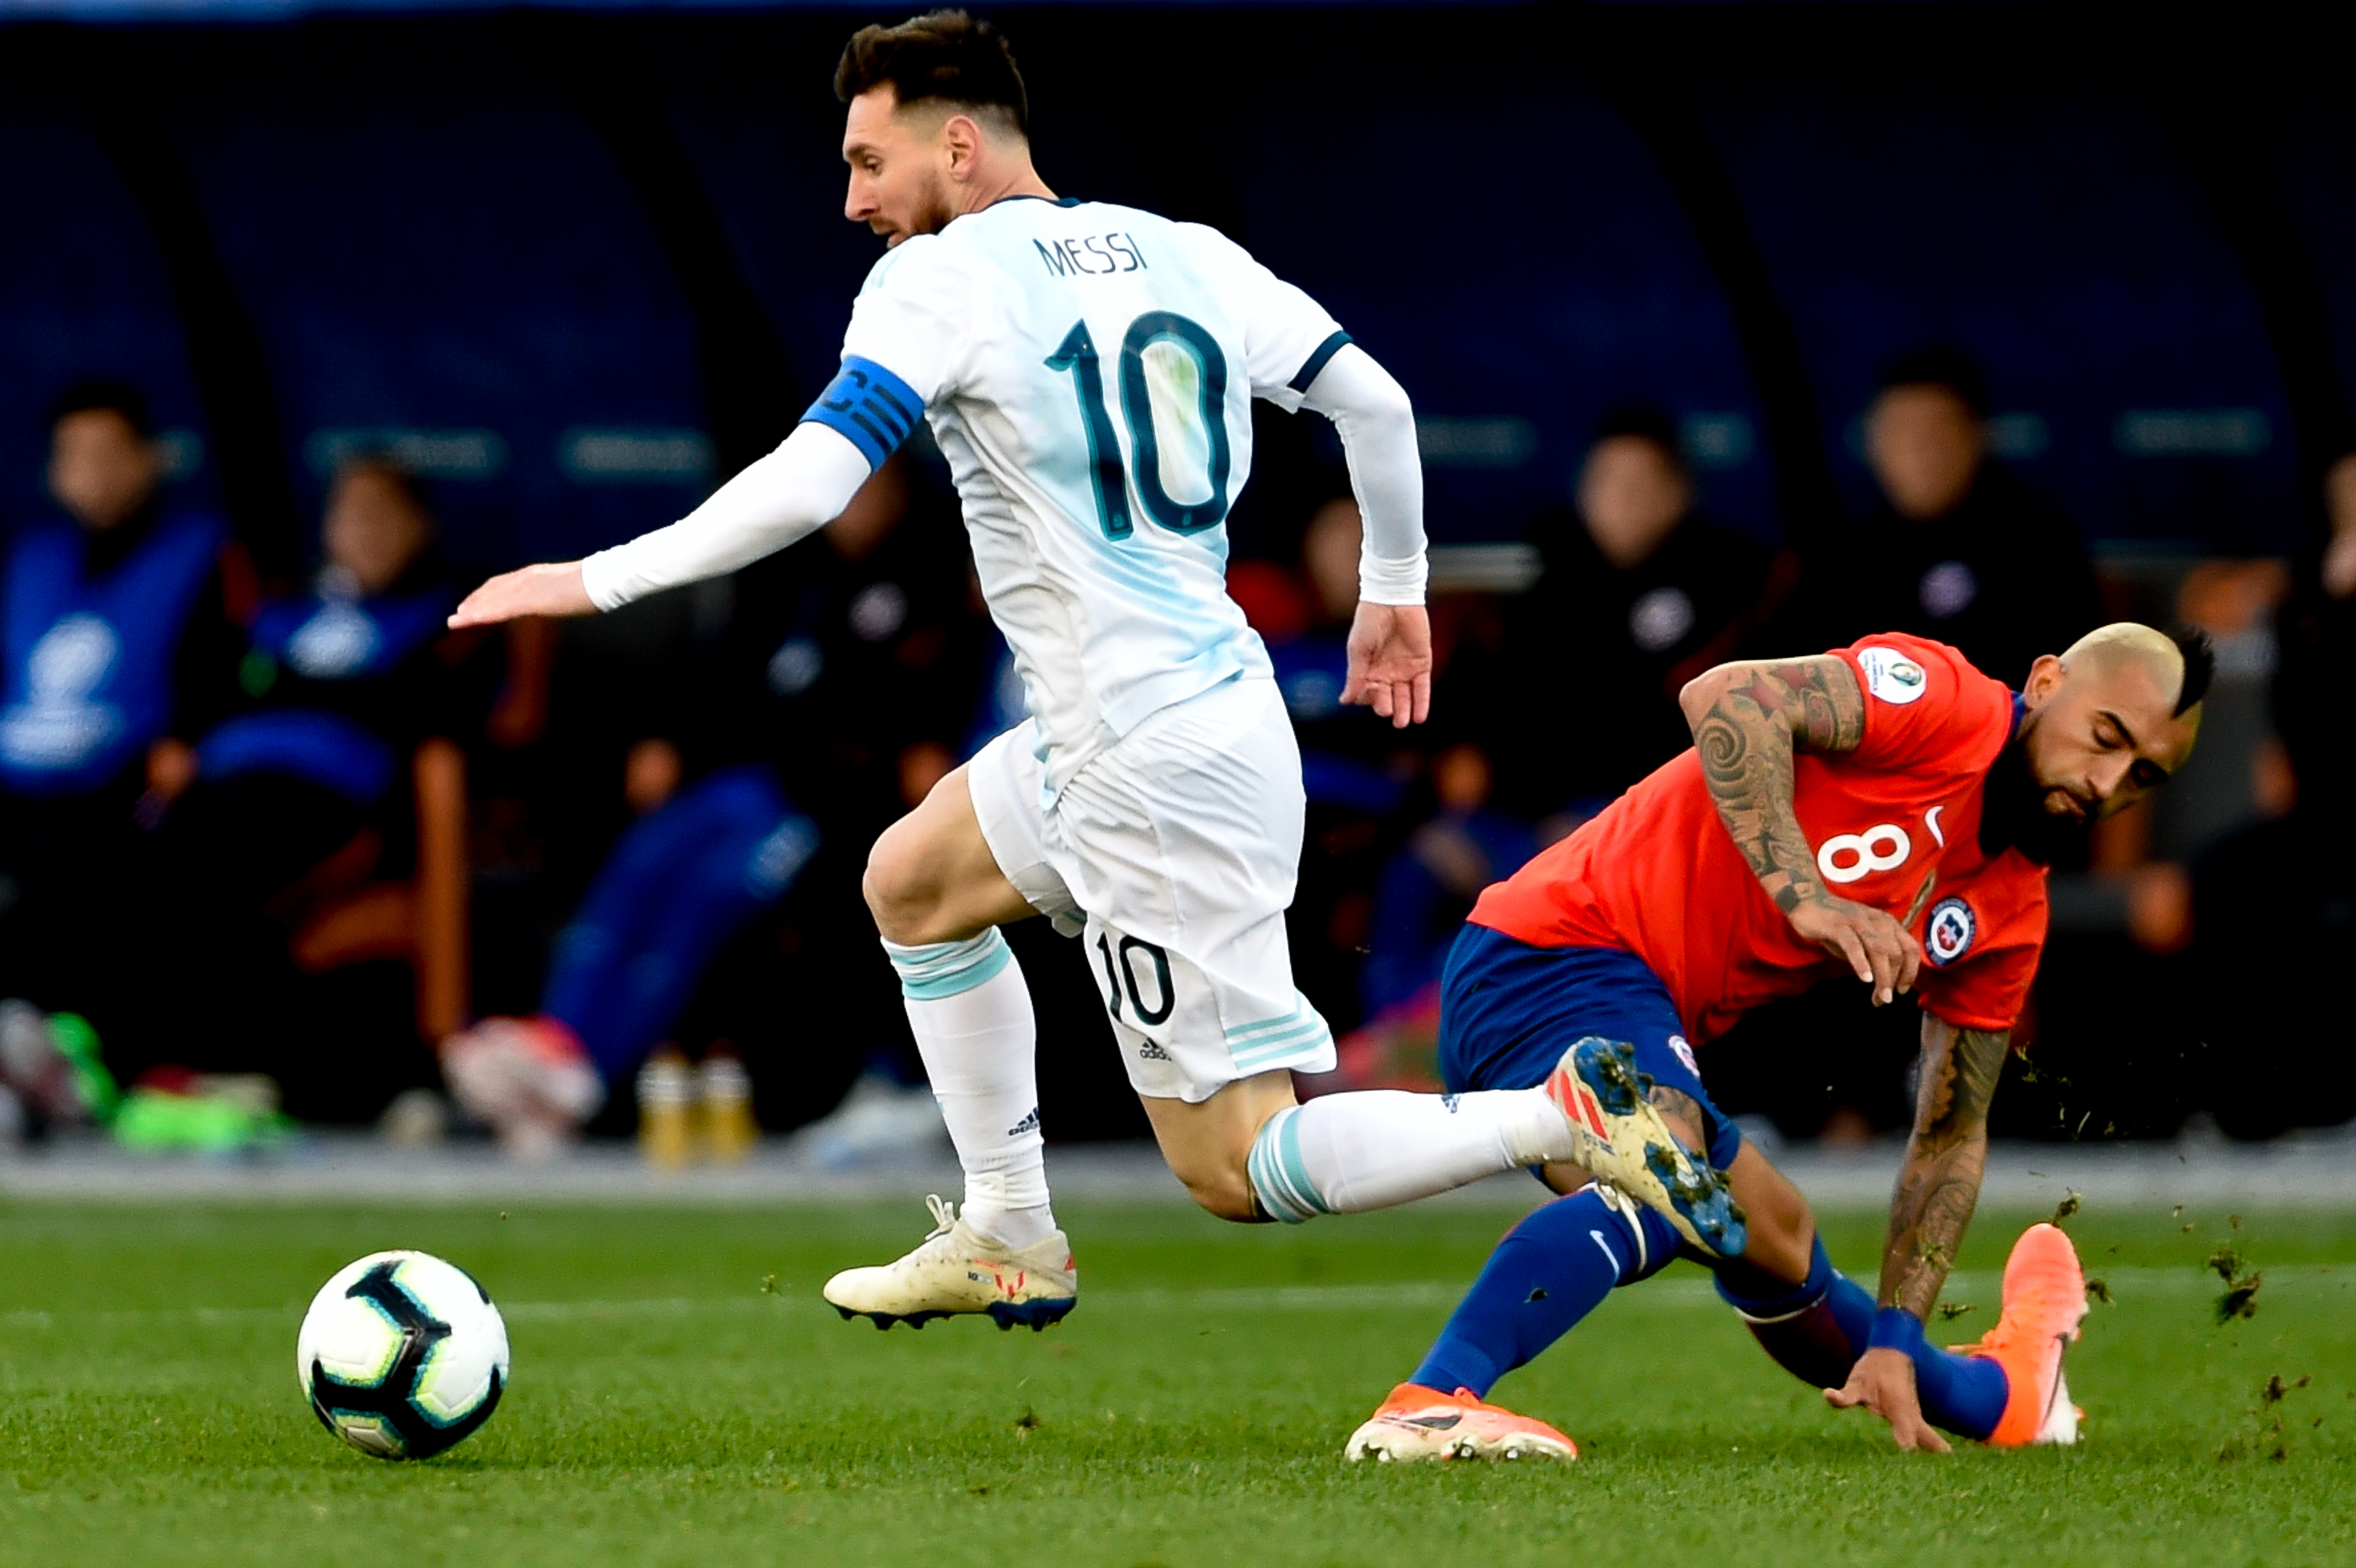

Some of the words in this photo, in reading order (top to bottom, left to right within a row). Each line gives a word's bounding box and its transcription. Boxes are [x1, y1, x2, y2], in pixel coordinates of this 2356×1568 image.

[1033, 232, 1147, 276] MESSI
[1042, 309, 1232, 542] 10
[1817, 823, 1911, 883] 8
[1096, 931, 1176, 1026] 10
[1139, 1048, 1172, 1061] adids
